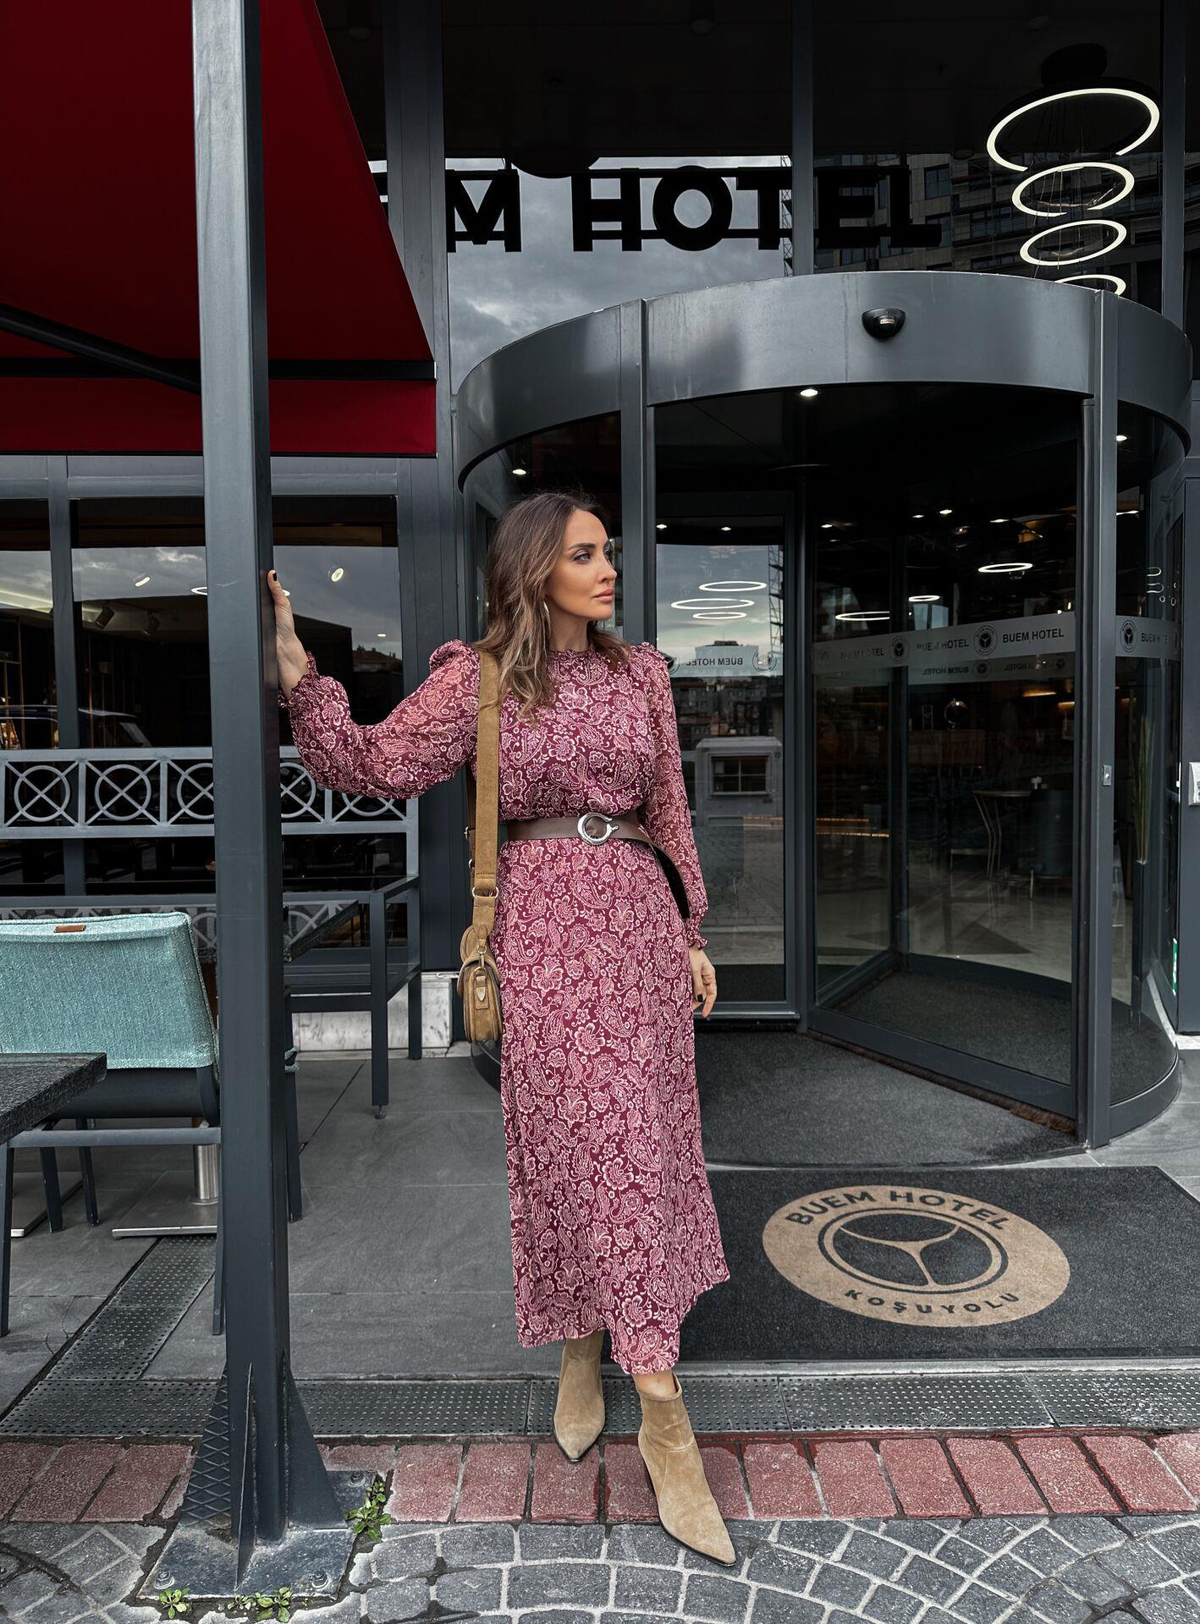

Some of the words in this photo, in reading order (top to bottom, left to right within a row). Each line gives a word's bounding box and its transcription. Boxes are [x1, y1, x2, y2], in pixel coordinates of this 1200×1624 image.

[571, 164, 942, 251] HOTEL
[941, 639, 969, 650] HOTEL
[1002, 631, 1029, 643] BUEM
[1031, 628, 1064, 640] HOTEL
[785, 1190, 877, 1225] BUEM
[890, 1190, 1012, 1230] HOTEL
[844, 1288, 1020, 1315] KOŞUYOLU
